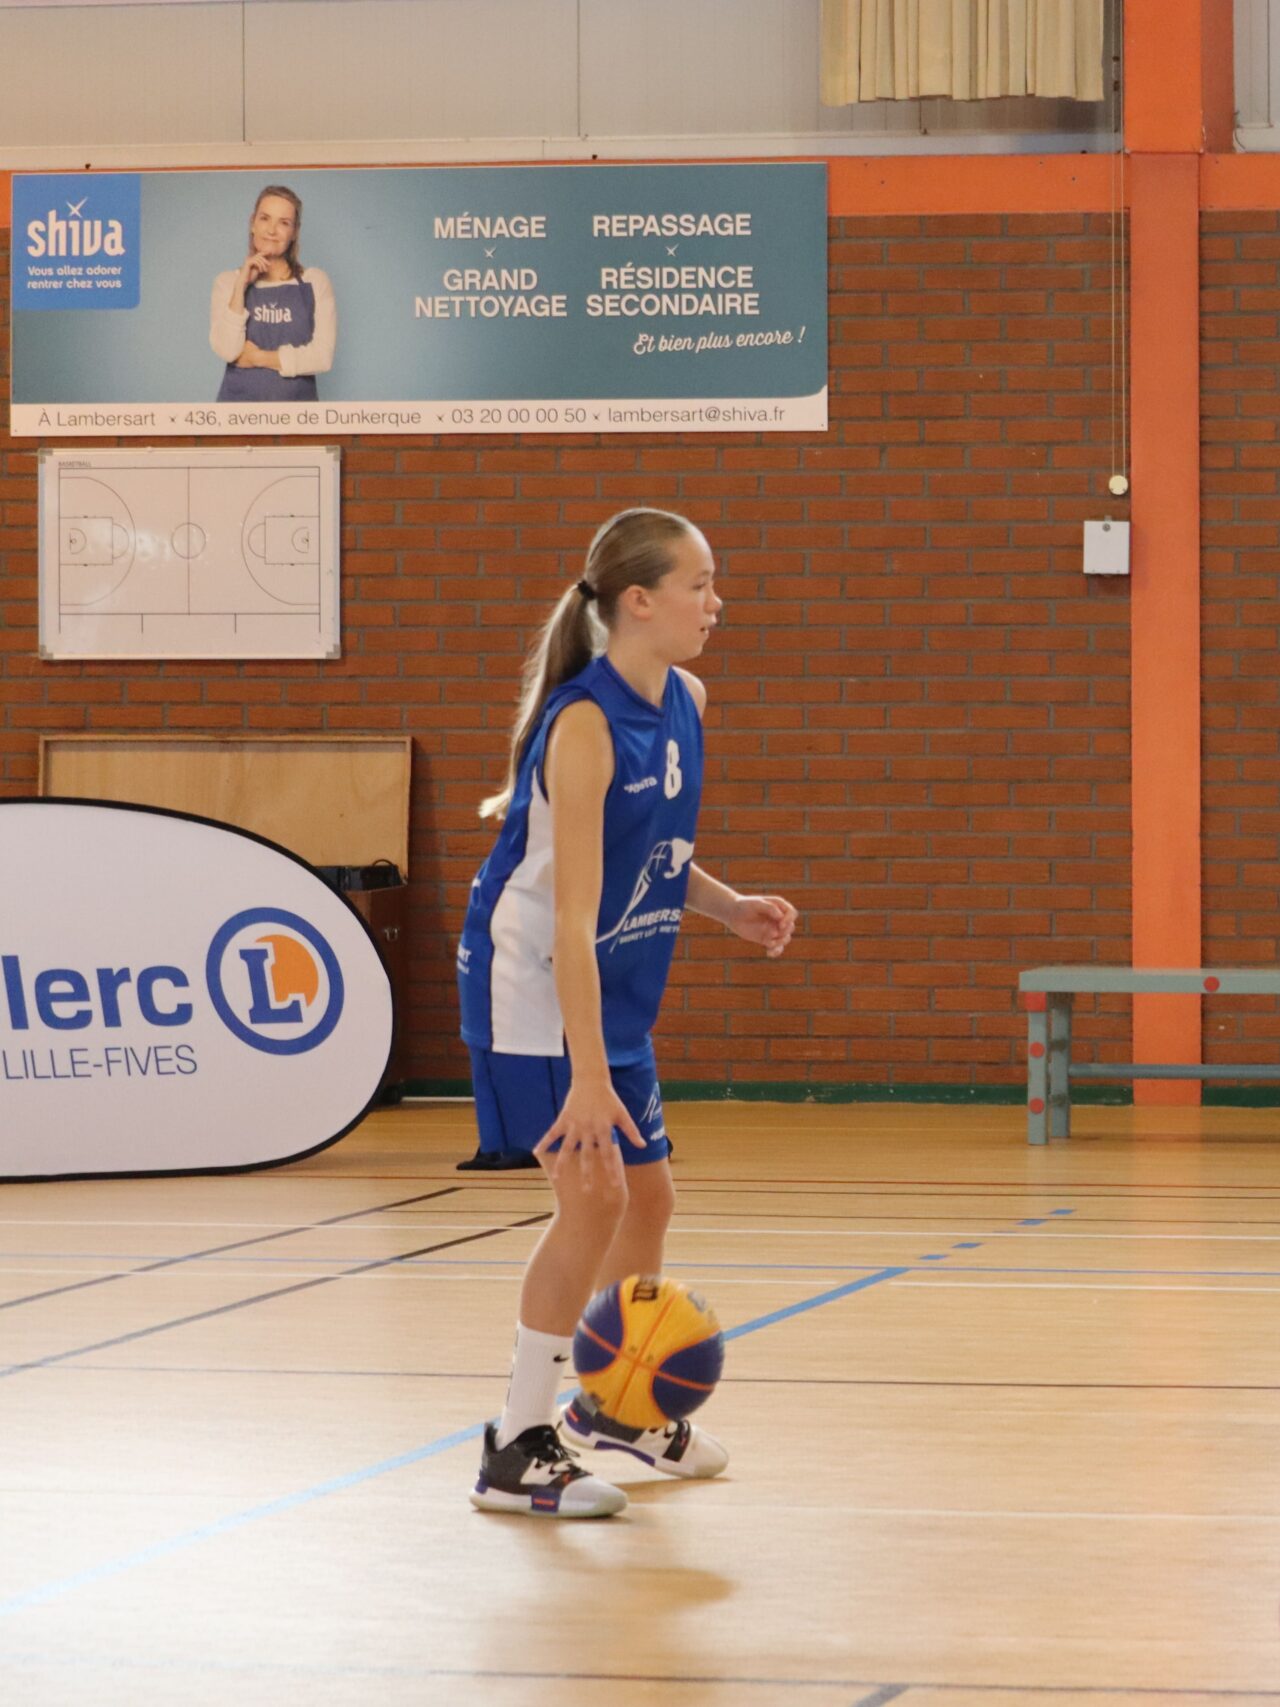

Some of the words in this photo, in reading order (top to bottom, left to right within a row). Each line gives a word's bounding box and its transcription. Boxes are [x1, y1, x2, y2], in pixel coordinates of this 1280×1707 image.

[27, 197, 126, 257] shiva
[433, 211, 547, 239] MÉNAGE
[592, 213, 752, 237] REPASSAGE
[27, 266, 54, 276] Vous
[57, 265, 83, 276] allez
[86, 265, 122, 276] adorer
[442, 268, 538, 291] GRAND
[600, 262, 753, 289] RÉSIDENCE
[27, 280, 63, 289] rentrer
[66, 279, 93, 289] chez
[96, 281, 122, 289] vous
[254, 302, 292, 324] shiva
[414, 294, 568, 318] NETTOYAGE
[586, 293, 760, 317] SECONDAIRE
[633, 333, 655, 355] Et
[657, 336, 695, 352] bien
[695, 331, 733, 354] plus
[735, 330, 794, 347] encore
[38, 408, 51, 427] À
[56, 411, 156, 427] Lambersart
[184, 410, 222, 427] 436,
[228, 413, 291, 425] avenue
[296, 409, 319, 424] de
[325, 409, 422, 427] Dunkerque
[451, 408, 474, 424] 03
[480, 408, 502, 424] 20
[507, 408, 530, 424] 00
[535, 407, 558, 423] 00
[564, 407, 587, 423] 50
[607, 406, 785, 423] lambersart@shiva.fr
[664, 739, 682, 800] 8
[623, 908, 684, 933] LAMBERS
[2, 1044, 198, 1080] LILLE-FIVES
